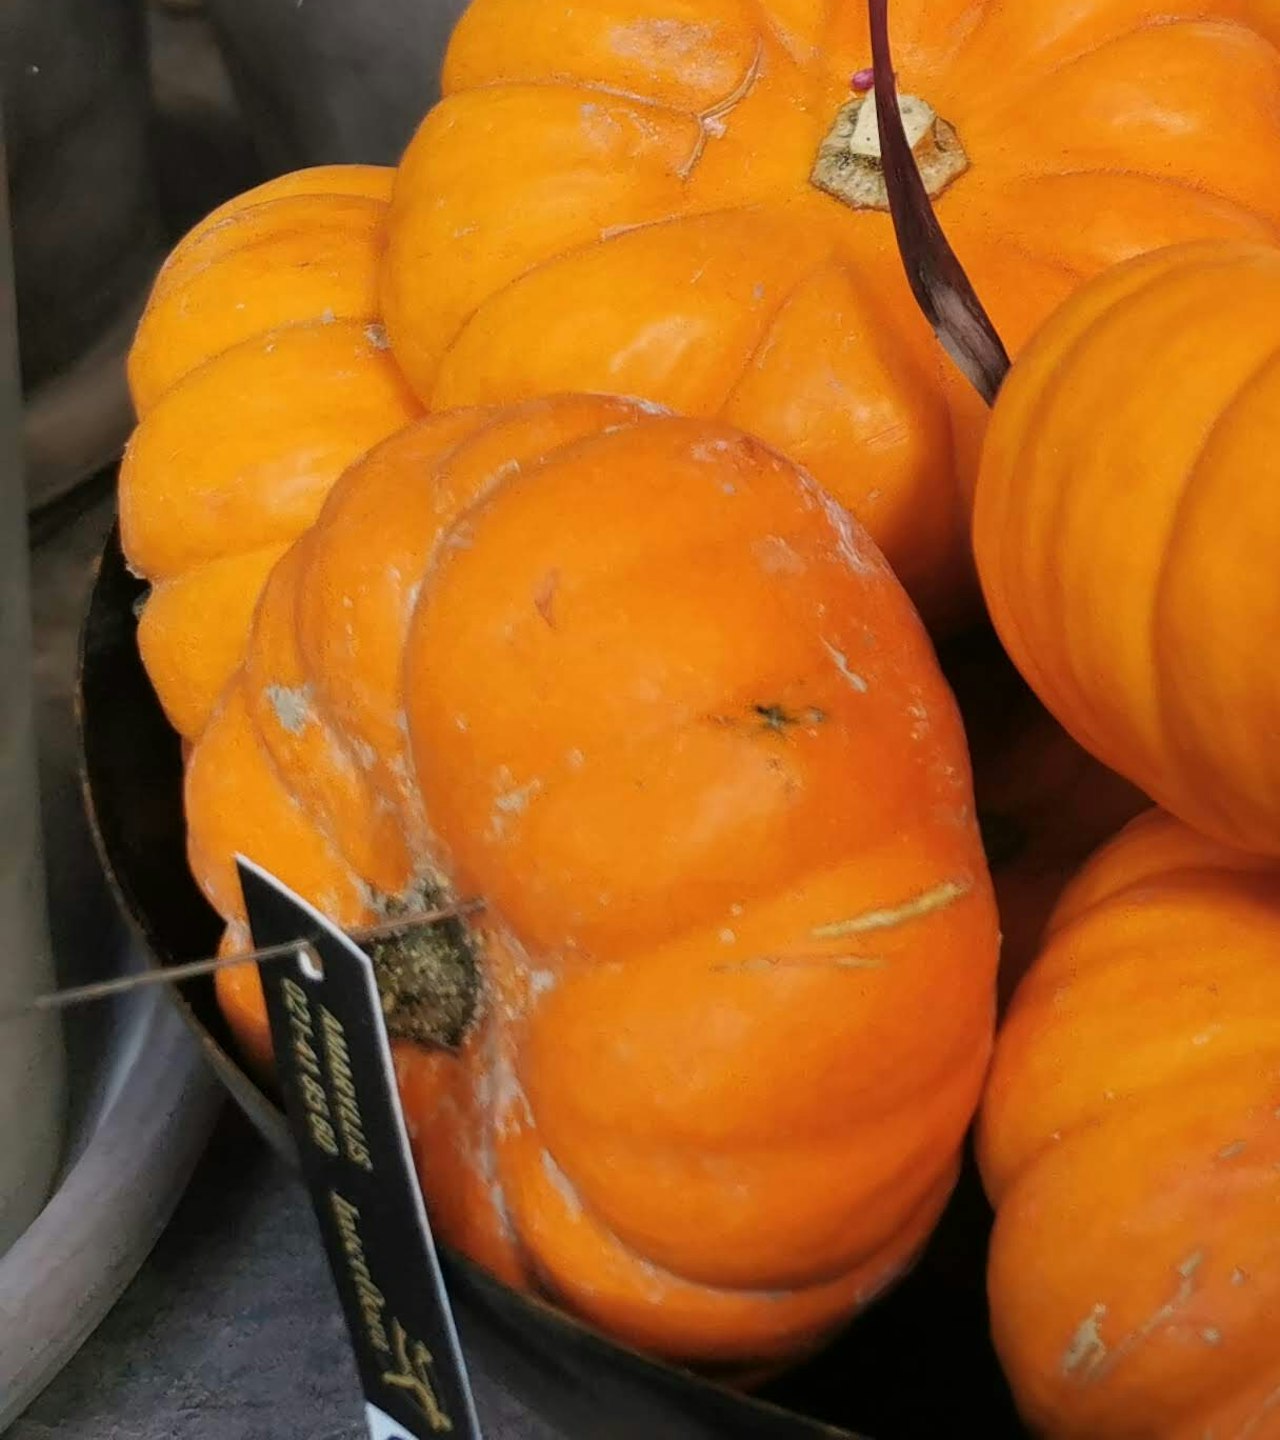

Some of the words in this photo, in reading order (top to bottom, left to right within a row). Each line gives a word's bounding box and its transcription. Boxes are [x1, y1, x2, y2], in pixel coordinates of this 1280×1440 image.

[302, 1073, 331, 1121] 85
[320, 1003, 374, 1172] AMARYLLIS
[309, 1112, 340, 1156] 60
